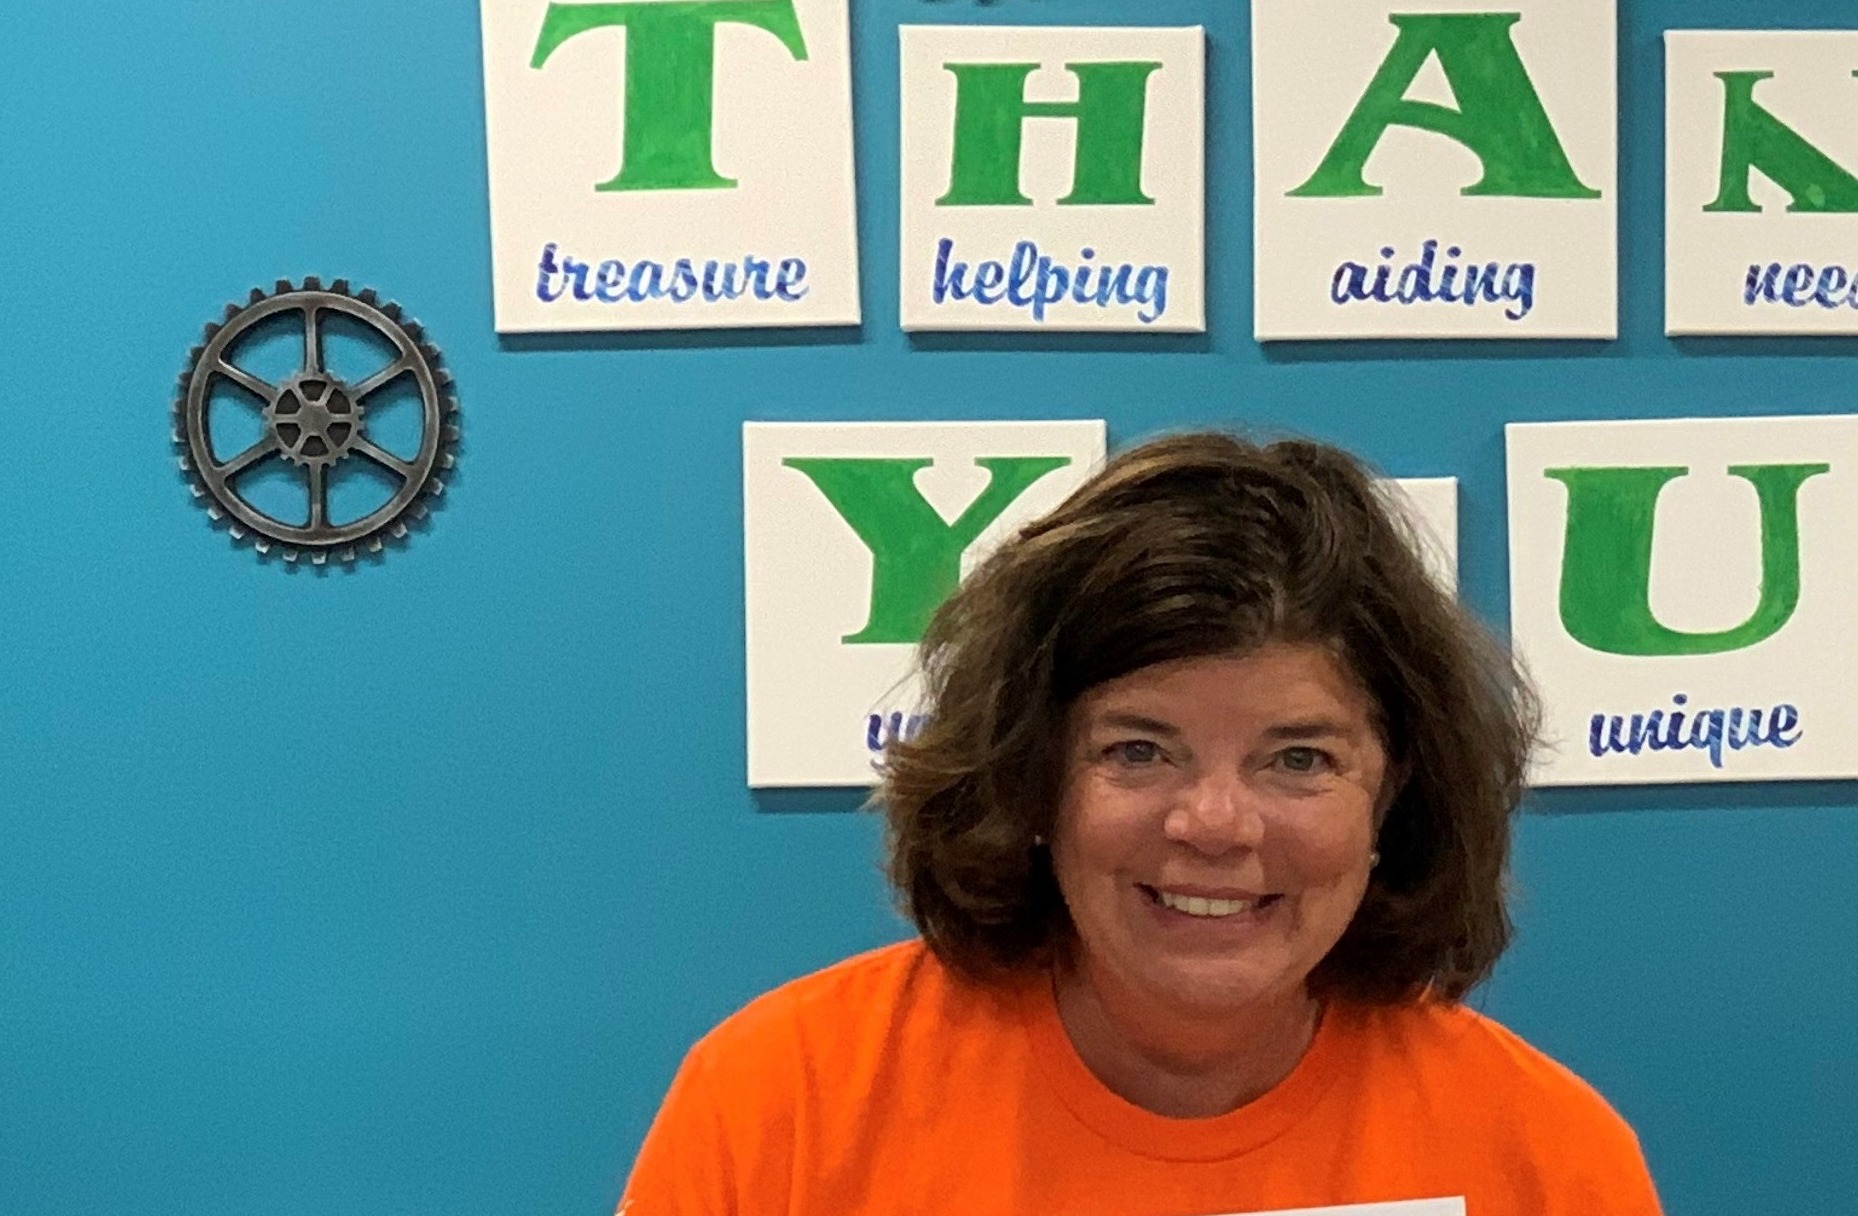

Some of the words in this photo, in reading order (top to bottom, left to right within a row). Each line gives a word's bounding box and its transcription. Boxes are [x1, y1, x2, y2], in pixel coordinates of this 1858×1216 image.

[535, 242, 810, 303] treasure
[931, 237, 1169, 323] helping
[1331, 239, 1536, 321] aiding
[1589, 694, 1803, 768] unique
